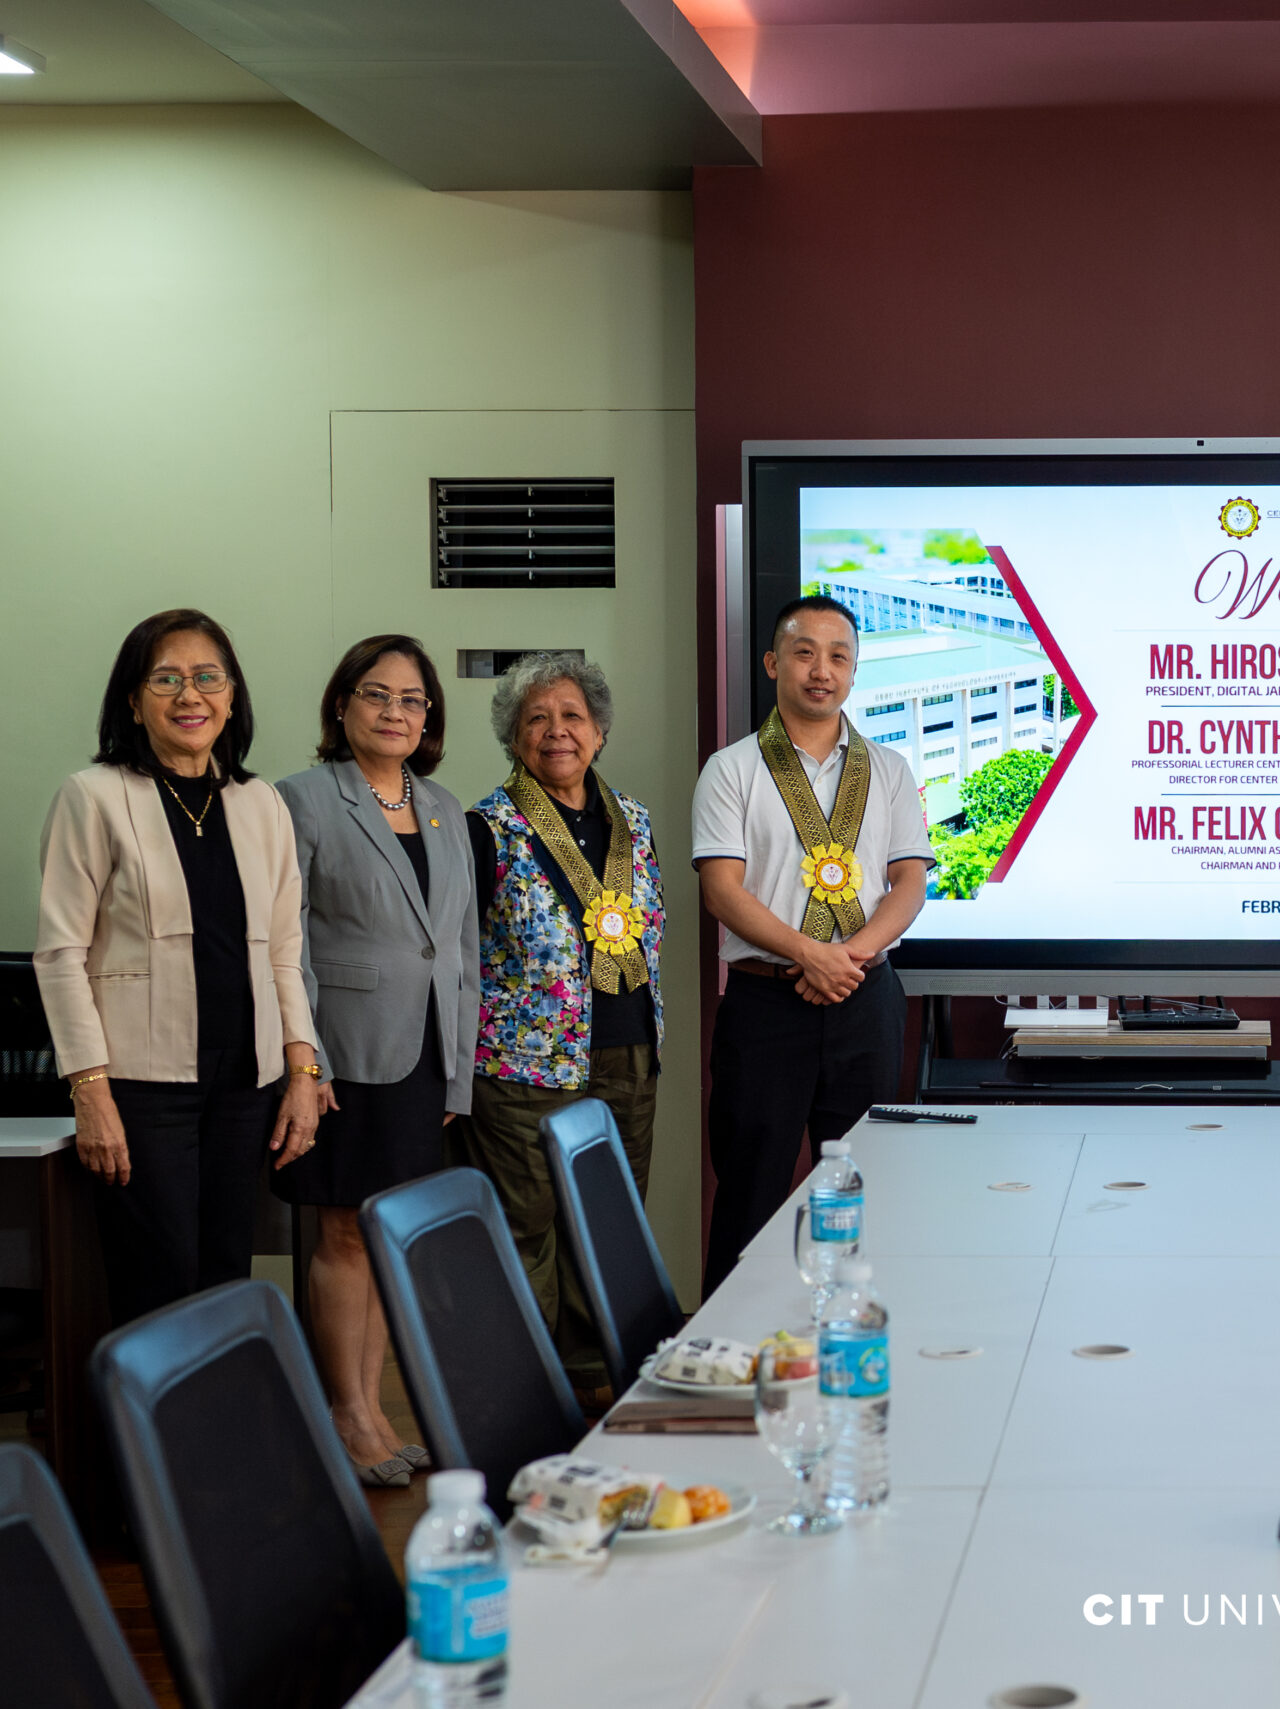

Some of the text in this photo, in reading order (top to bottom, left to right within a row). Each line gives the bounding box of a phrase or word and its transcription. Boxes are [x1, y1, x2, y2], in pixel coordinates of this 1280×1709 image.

[1150, 643, 1201, 679] MR.
[1146, 686, 1214, 698] PRESIDENT,
[1217, 686, 1263, 696] DIGITAL
[1149, 720, 1191, 754] DR.
[1131, 760, 1203, 769] PROFESSORIAL
[1205, 760, 1254, 769] LECTURER
[1169, 775, 1217, 784] DIRECTOR
[1219, 775, 1238, 784] FOR
[1240, 775, 1277, 784] CENTER
[1135, 806, 1183, 840] MR.
[1193, 806, 1266, 840] FELIX
[1171, 846, 1226, 856] CHAIRMAN,
[1228, 846, 1266, 855] ALUMNI
[1201, 861, 1253, 870] CHAIRMAN
[1255, 861, 1276, 870] AND
